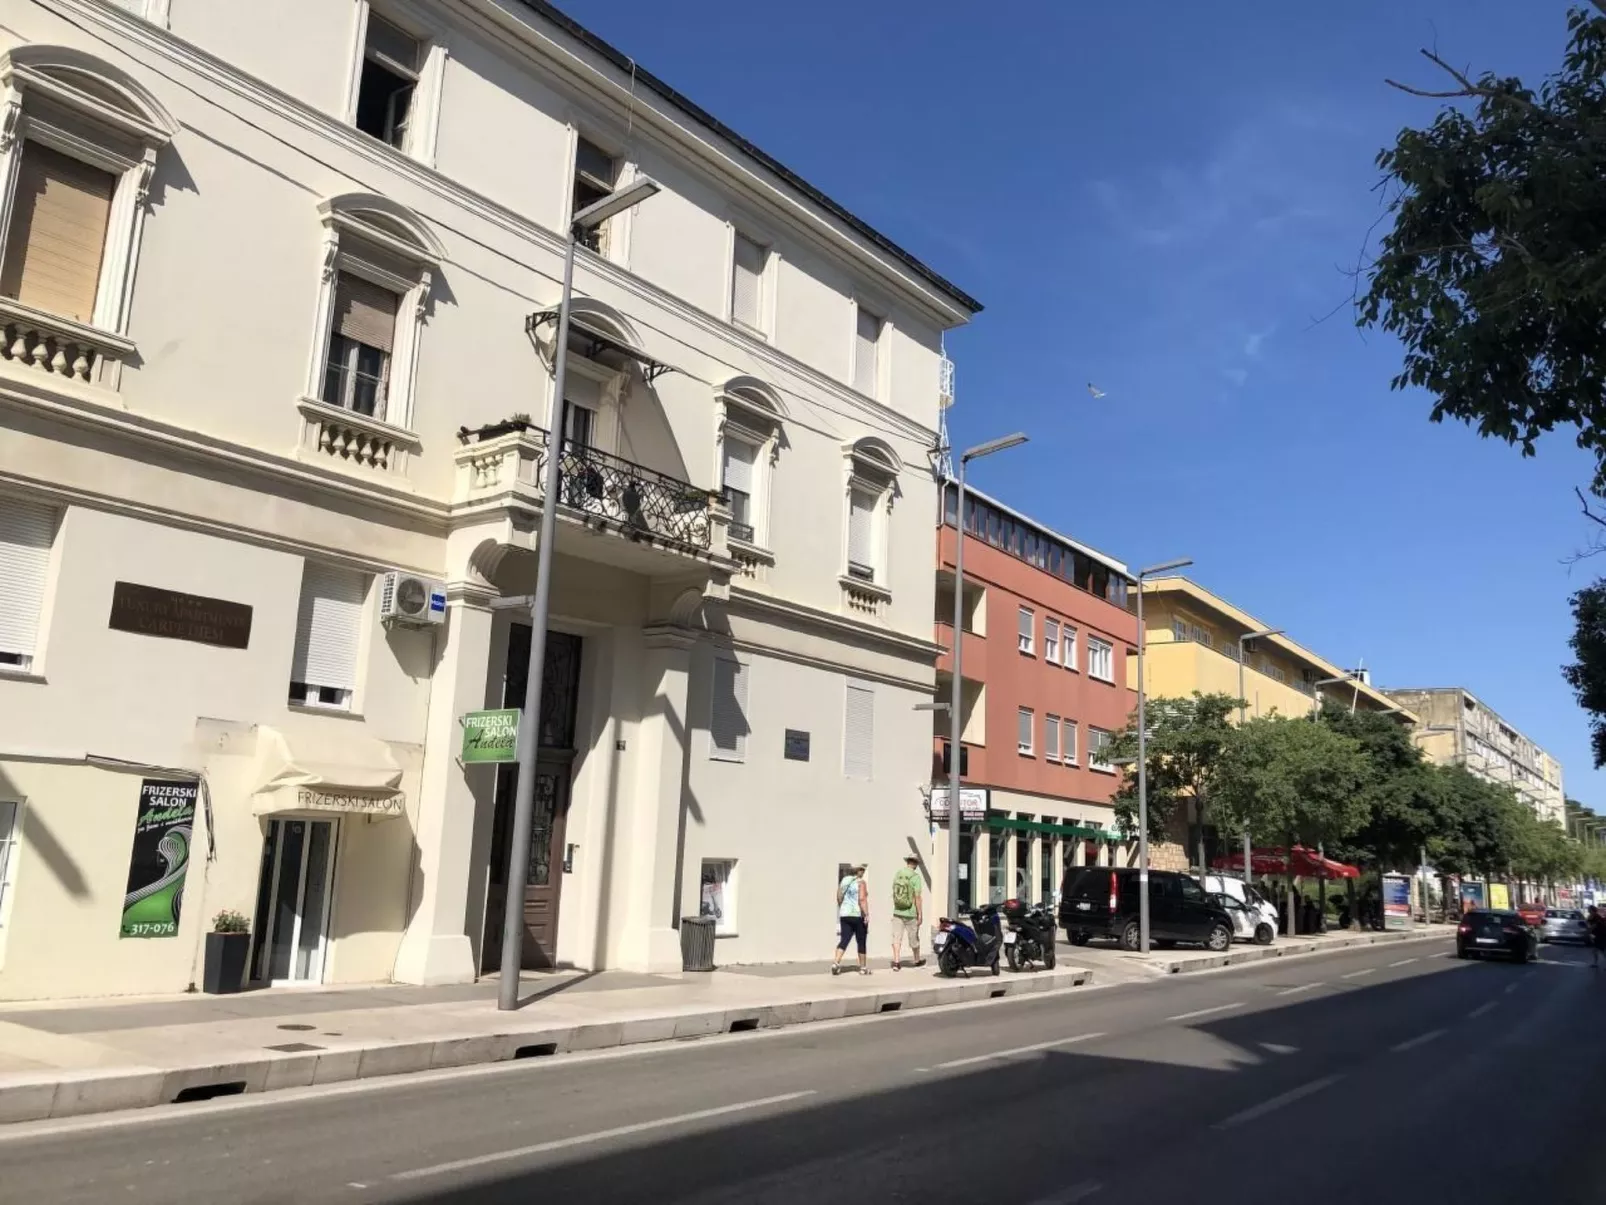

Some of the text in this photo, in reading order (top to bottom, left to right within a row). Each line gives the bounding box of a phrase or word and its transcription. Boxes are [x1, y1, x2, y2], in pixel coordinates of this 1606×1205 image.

[466, 715, 512, 728] FRIZERSKI
[484, 726, 517, 738] SALON
[142, 785, 197, 798] FRIZERSKI
[149, 796, 187, 807] SALON
[297, 791, 402, 810] FRIZERSKI SALON
[130, 922, 175, 935] 317-076
